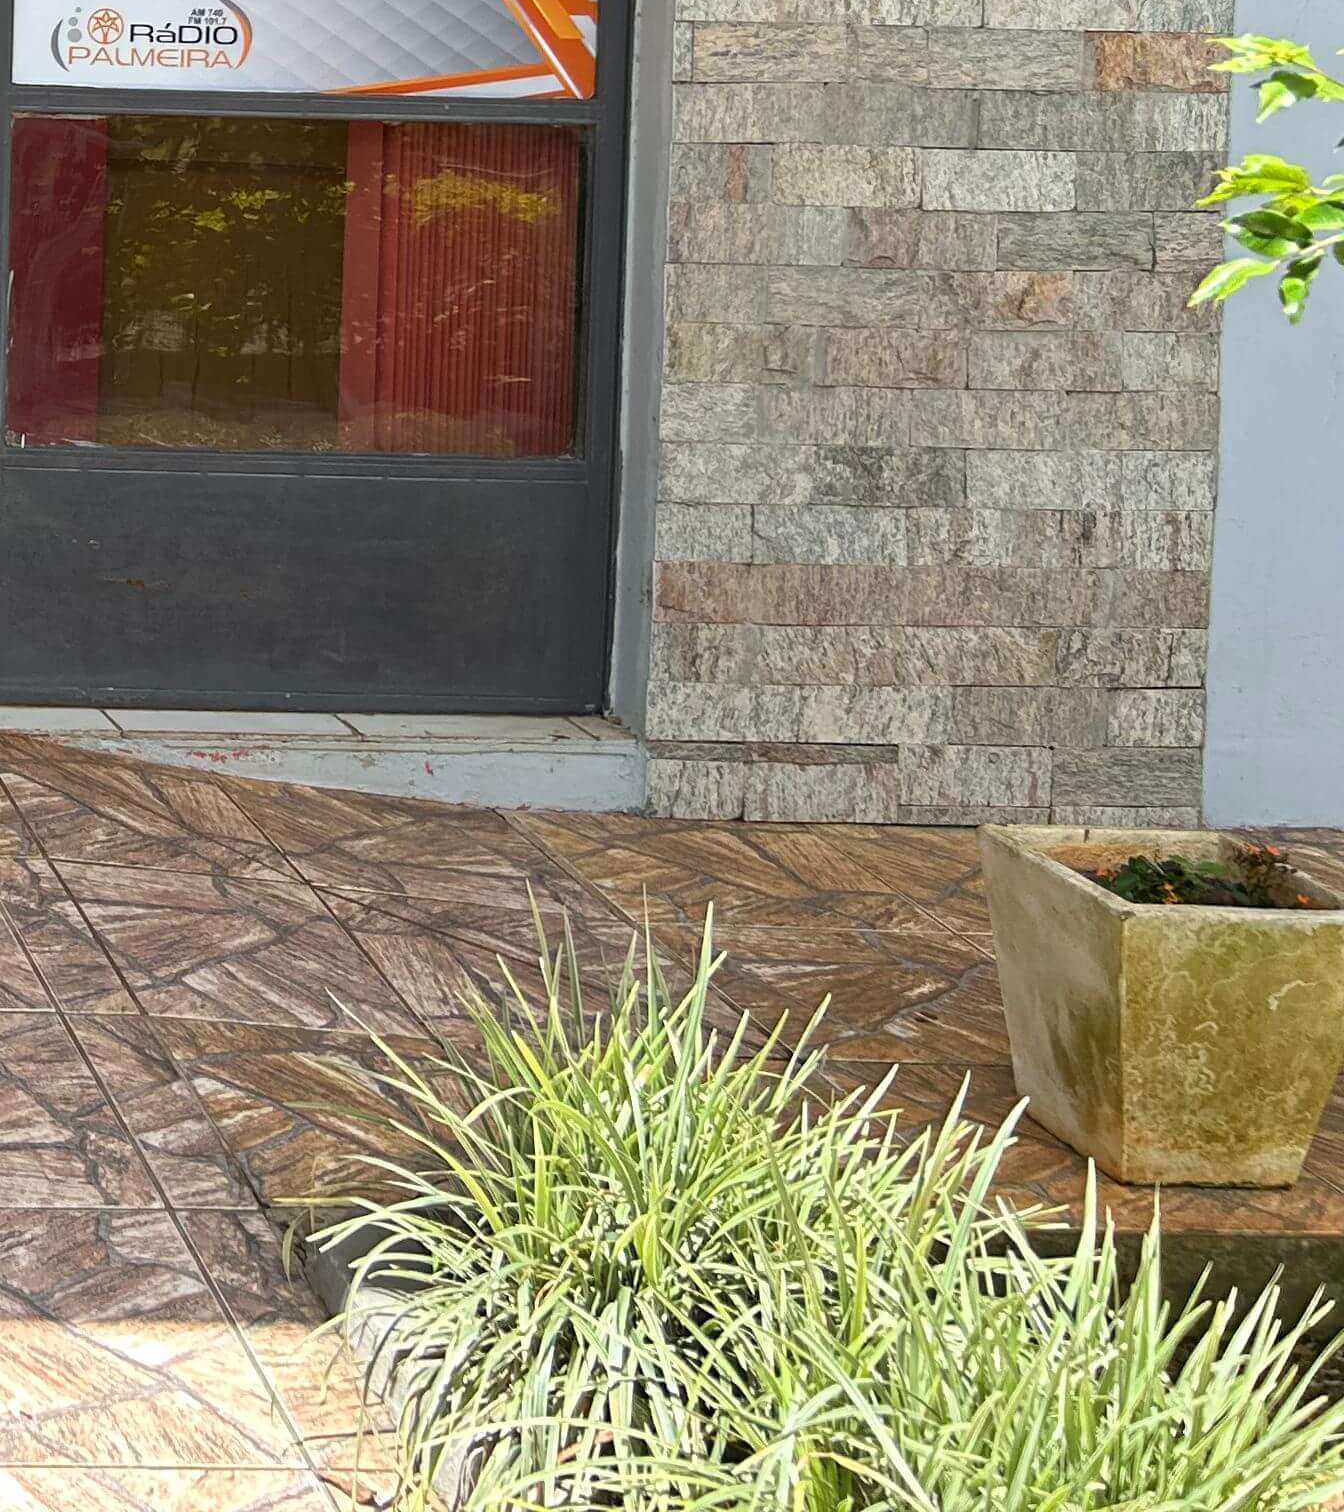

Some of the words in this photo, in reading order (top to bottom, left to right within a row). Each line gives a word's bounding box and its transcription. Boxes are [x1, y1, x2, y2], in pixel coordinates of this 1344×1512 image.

[191, 8, 206, 17] AM
[188, 16, 202, 25] FM
[68, 46, 233, 69] PALMEIRA
